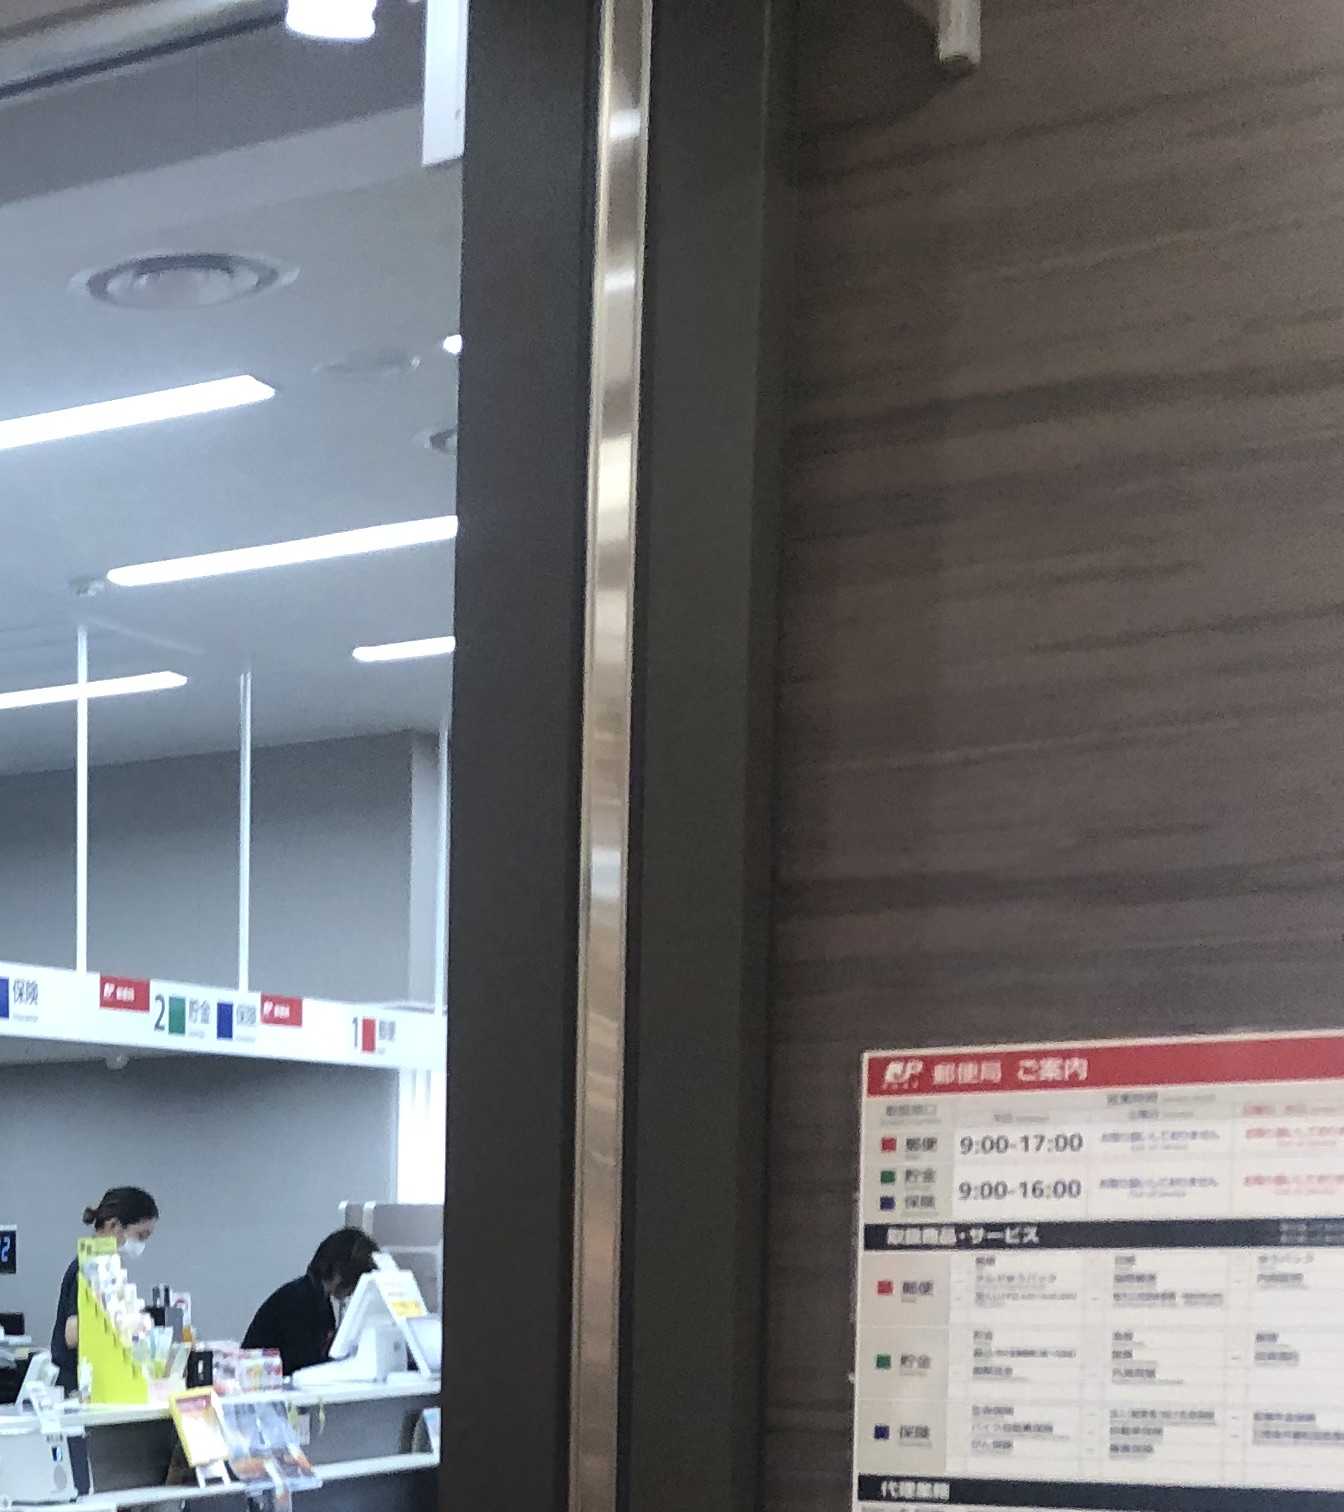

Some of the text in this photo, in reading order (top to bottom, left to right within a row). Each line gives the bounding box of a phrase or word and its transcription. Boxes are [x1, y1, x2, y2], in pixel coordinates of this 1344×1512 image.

[13, 978, 39, 1006] 保険
[154, 994, 166, 1032] 2
[352, 1016, 359, 1049] 1
[933, 1060, 1002, 1085] 郵便局
[1017, 1057, 1089, 1082] ご案内
[960, 1133, 1084, 1154] 9:00-17:00
[958, 1179, 1083, 1201] 9:00-16:00
